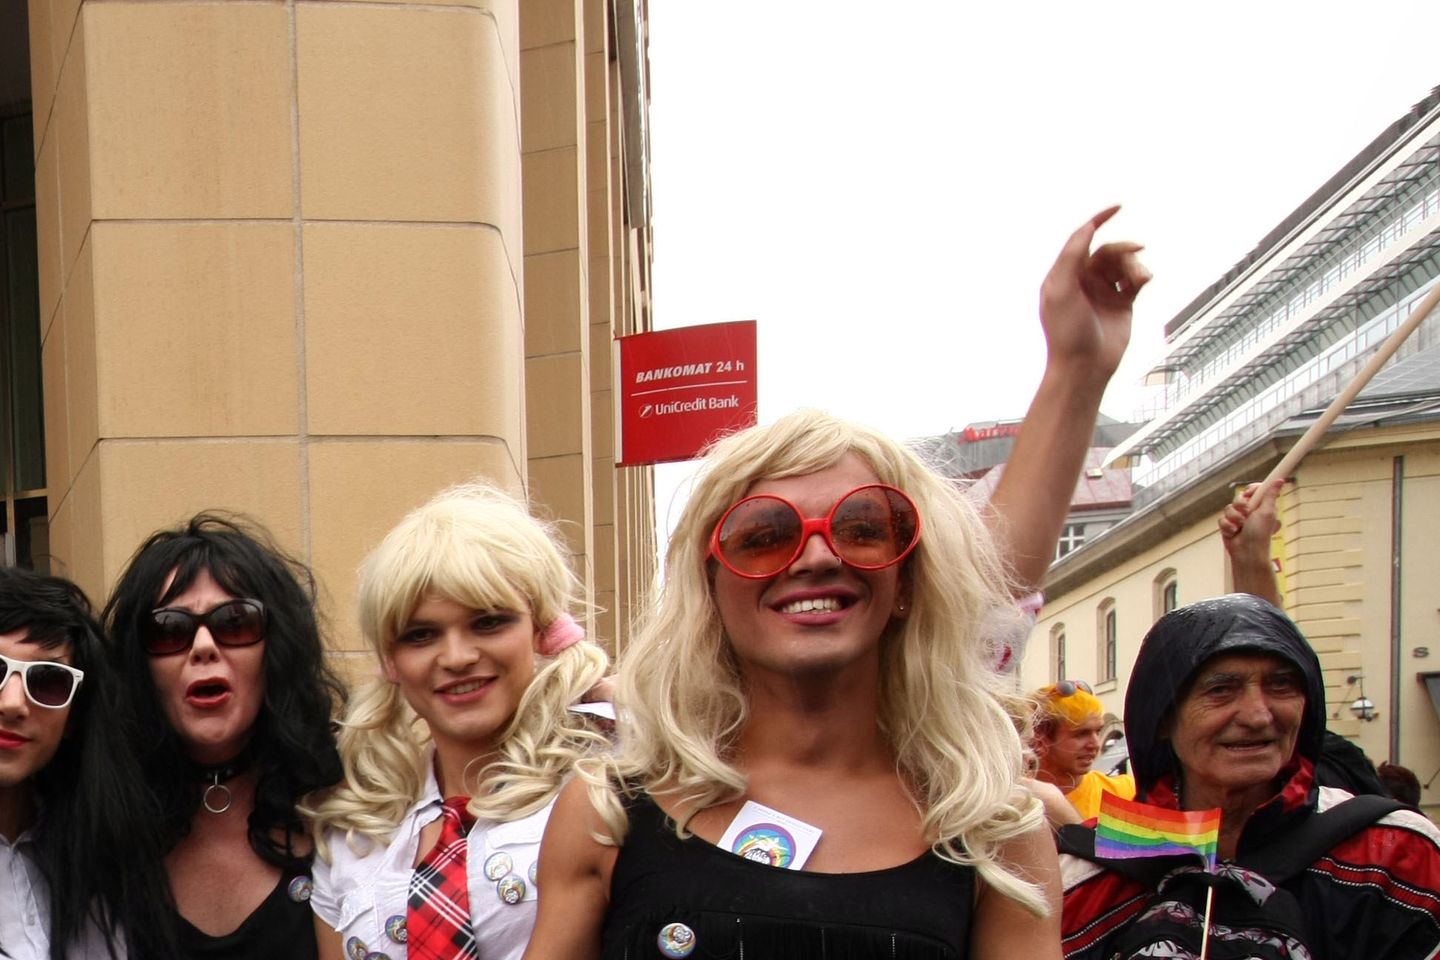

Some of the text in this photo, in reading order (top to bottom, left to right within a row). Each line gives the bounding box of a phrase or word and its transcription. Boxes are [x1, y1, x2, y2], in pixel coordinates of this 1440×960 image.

[636, 360, 744, 383] BANKOMAT 24 h
[655, 395, 739, 415] UniCredit Bank
